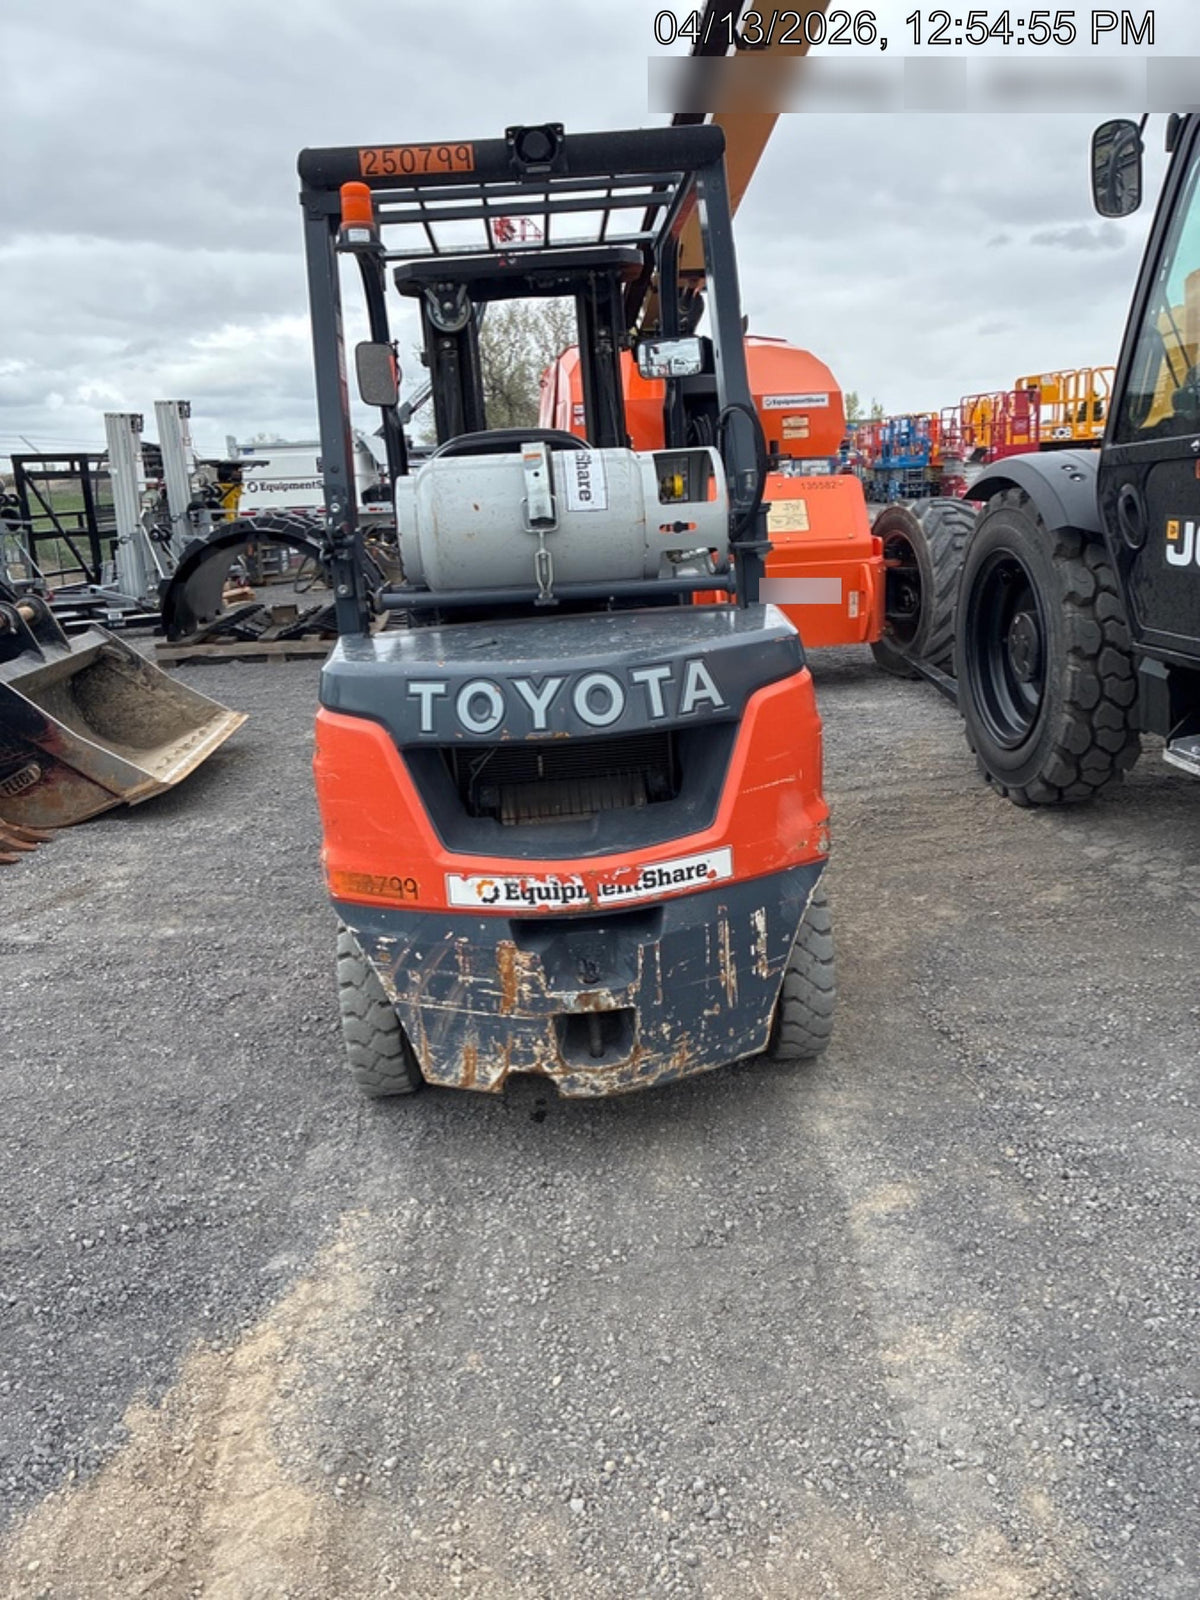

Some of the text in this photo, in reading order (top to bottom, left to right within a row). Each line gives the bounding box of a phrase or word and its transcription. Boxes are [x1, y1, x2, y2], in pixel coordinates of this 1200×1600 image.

[363, 145, 471, 175] 250799
[1166, 521, 1200, 566] J
[406, 659, 725, 733] TOYOTA
